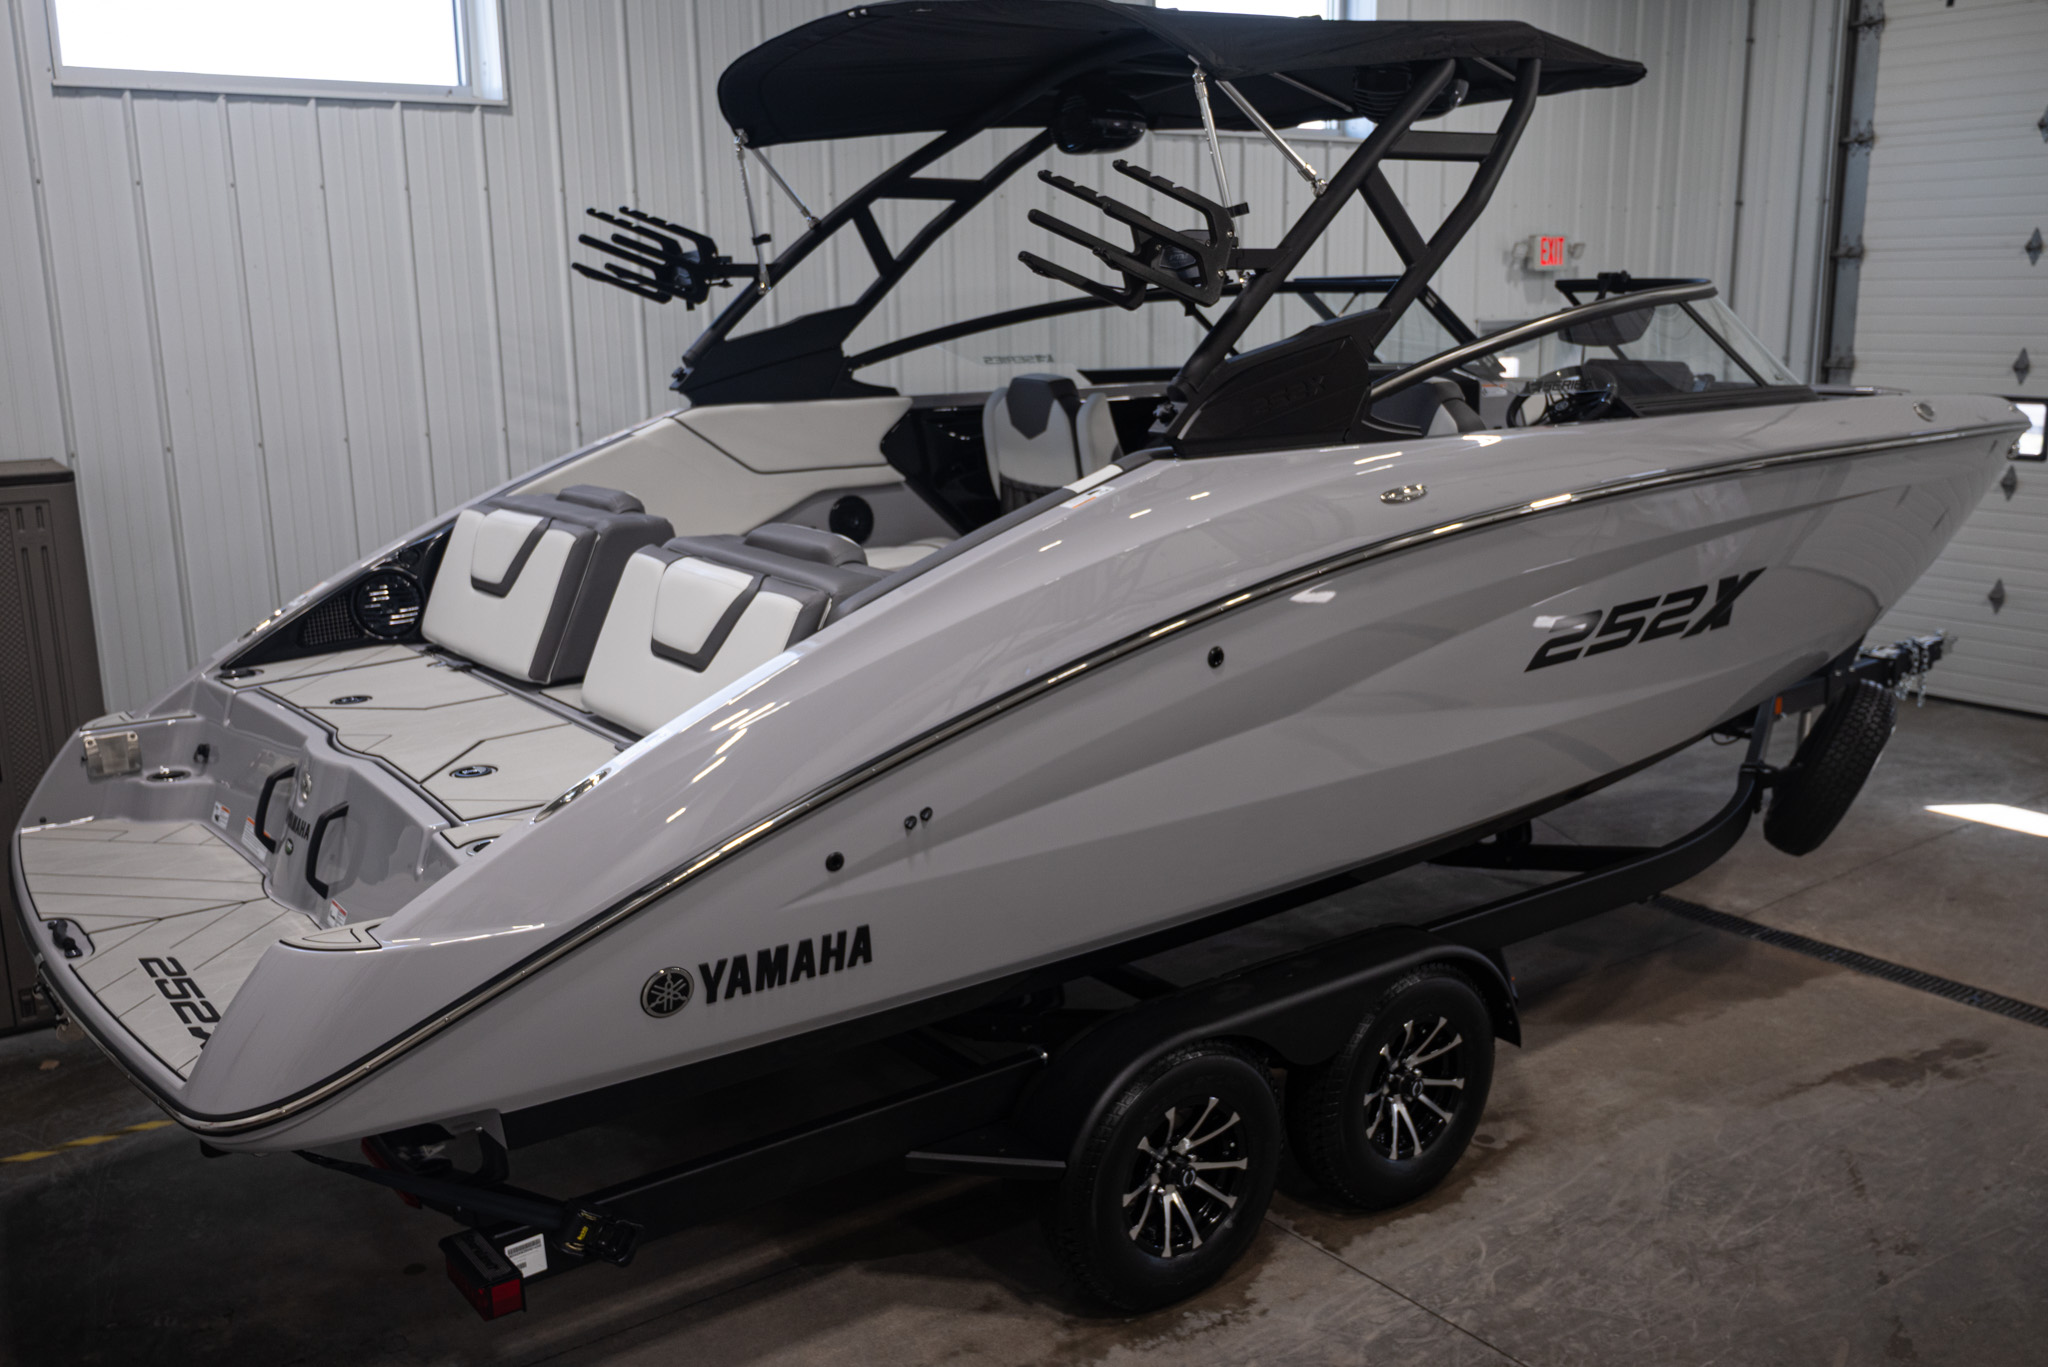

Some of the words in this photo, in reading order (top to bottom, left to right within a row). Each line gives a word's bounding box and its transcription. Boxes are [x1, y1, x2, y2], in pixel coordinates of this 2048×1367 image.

[1541, 236, 1564, 265] EXIT
[1524, 567, 1767, 673] 252X
[698, 923, 873, 1004] YAMAHA
